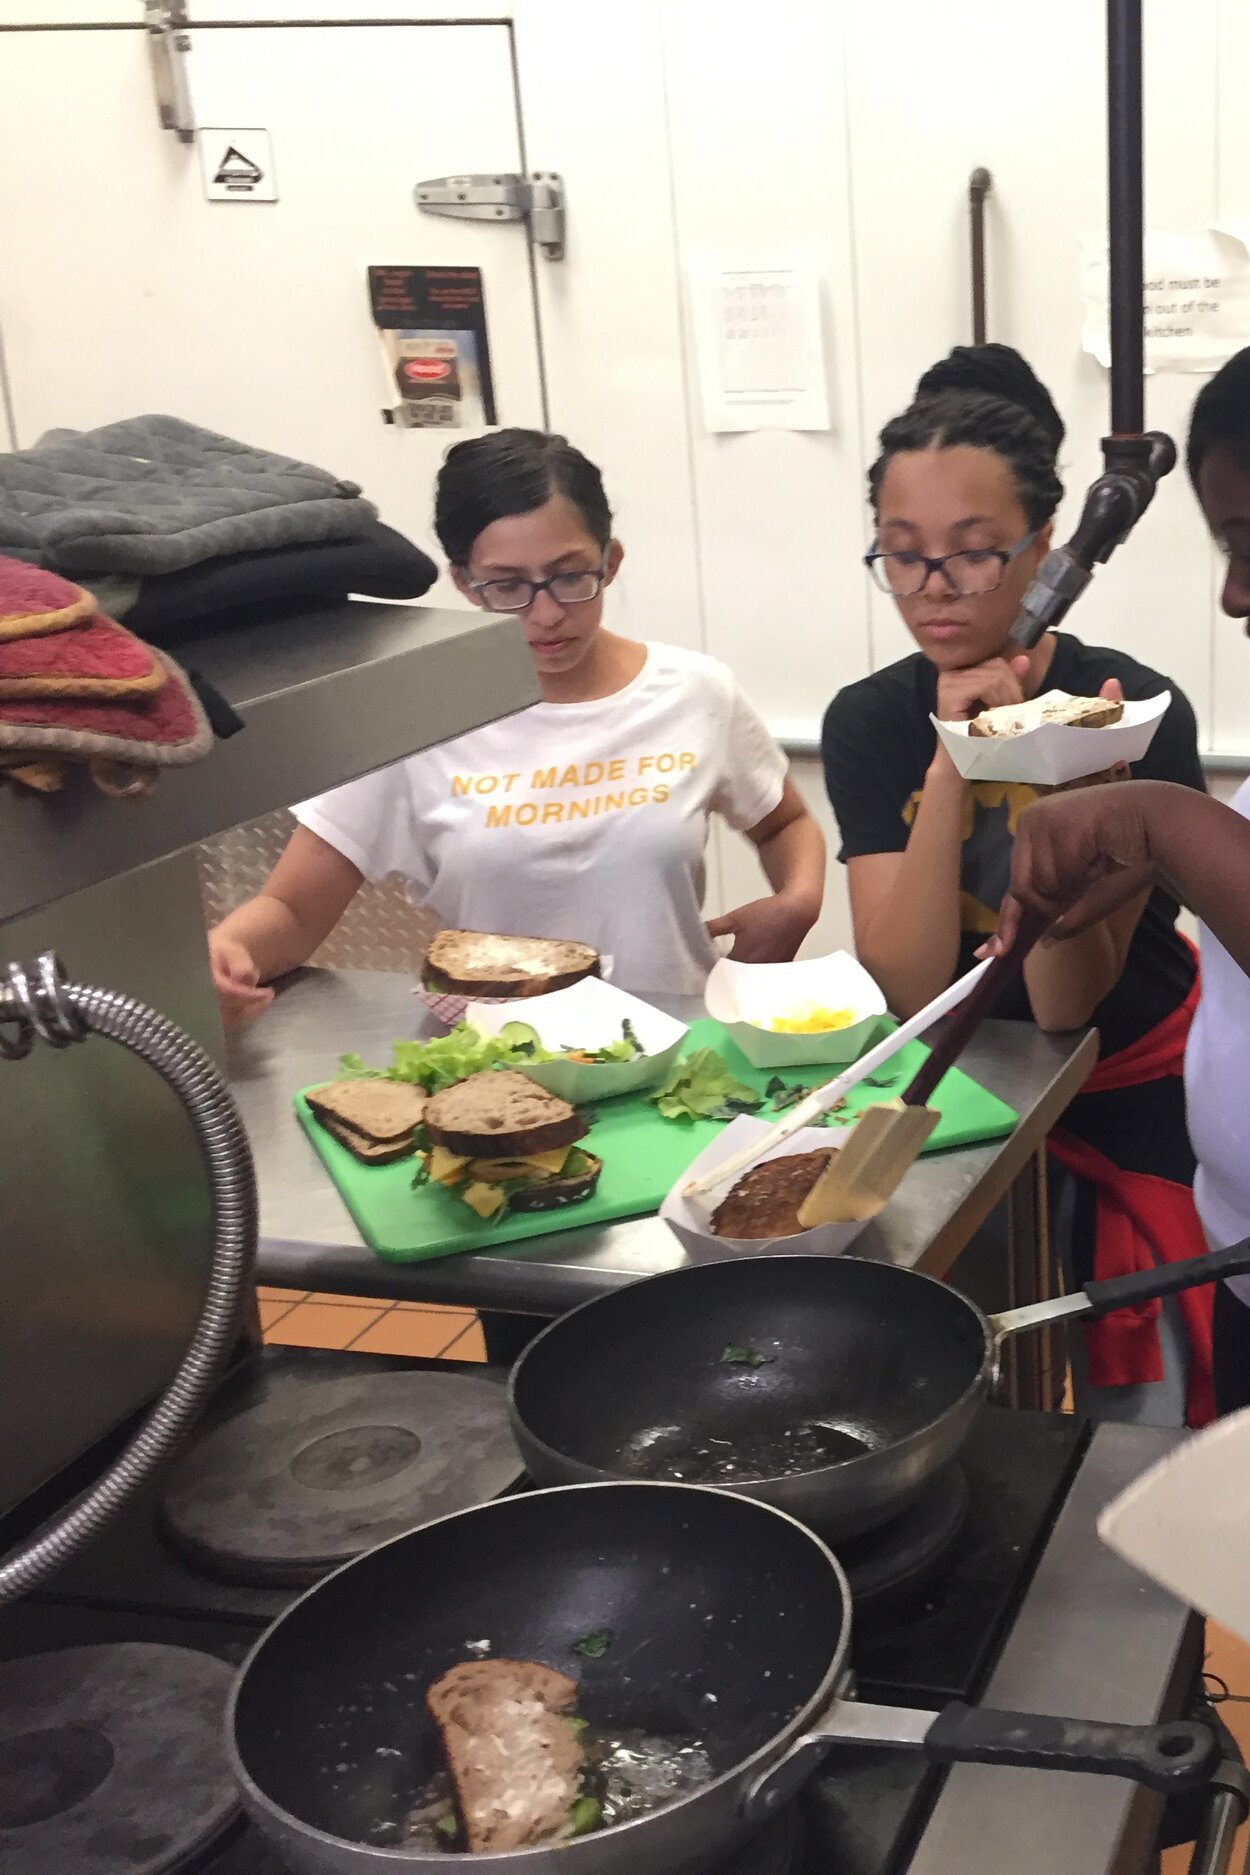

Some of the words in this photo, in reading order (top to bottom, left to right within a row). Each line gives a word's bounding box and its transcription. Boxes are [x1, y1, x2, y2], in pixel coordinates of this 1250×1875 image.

[1168, 279, 1200, 290] must
[1203, 276, 1220, 289] be
[1155, 303, 1178, 314] out
[1180, 300, 1195, 313] of
[1196, 301, 1220, 313] the
[450, 772, 522, 797] NOT
[530, 758, 626, 789] MADE
[638, 752, 697, 777] FOR
[484, 783, 672, 829] MORNINGS
